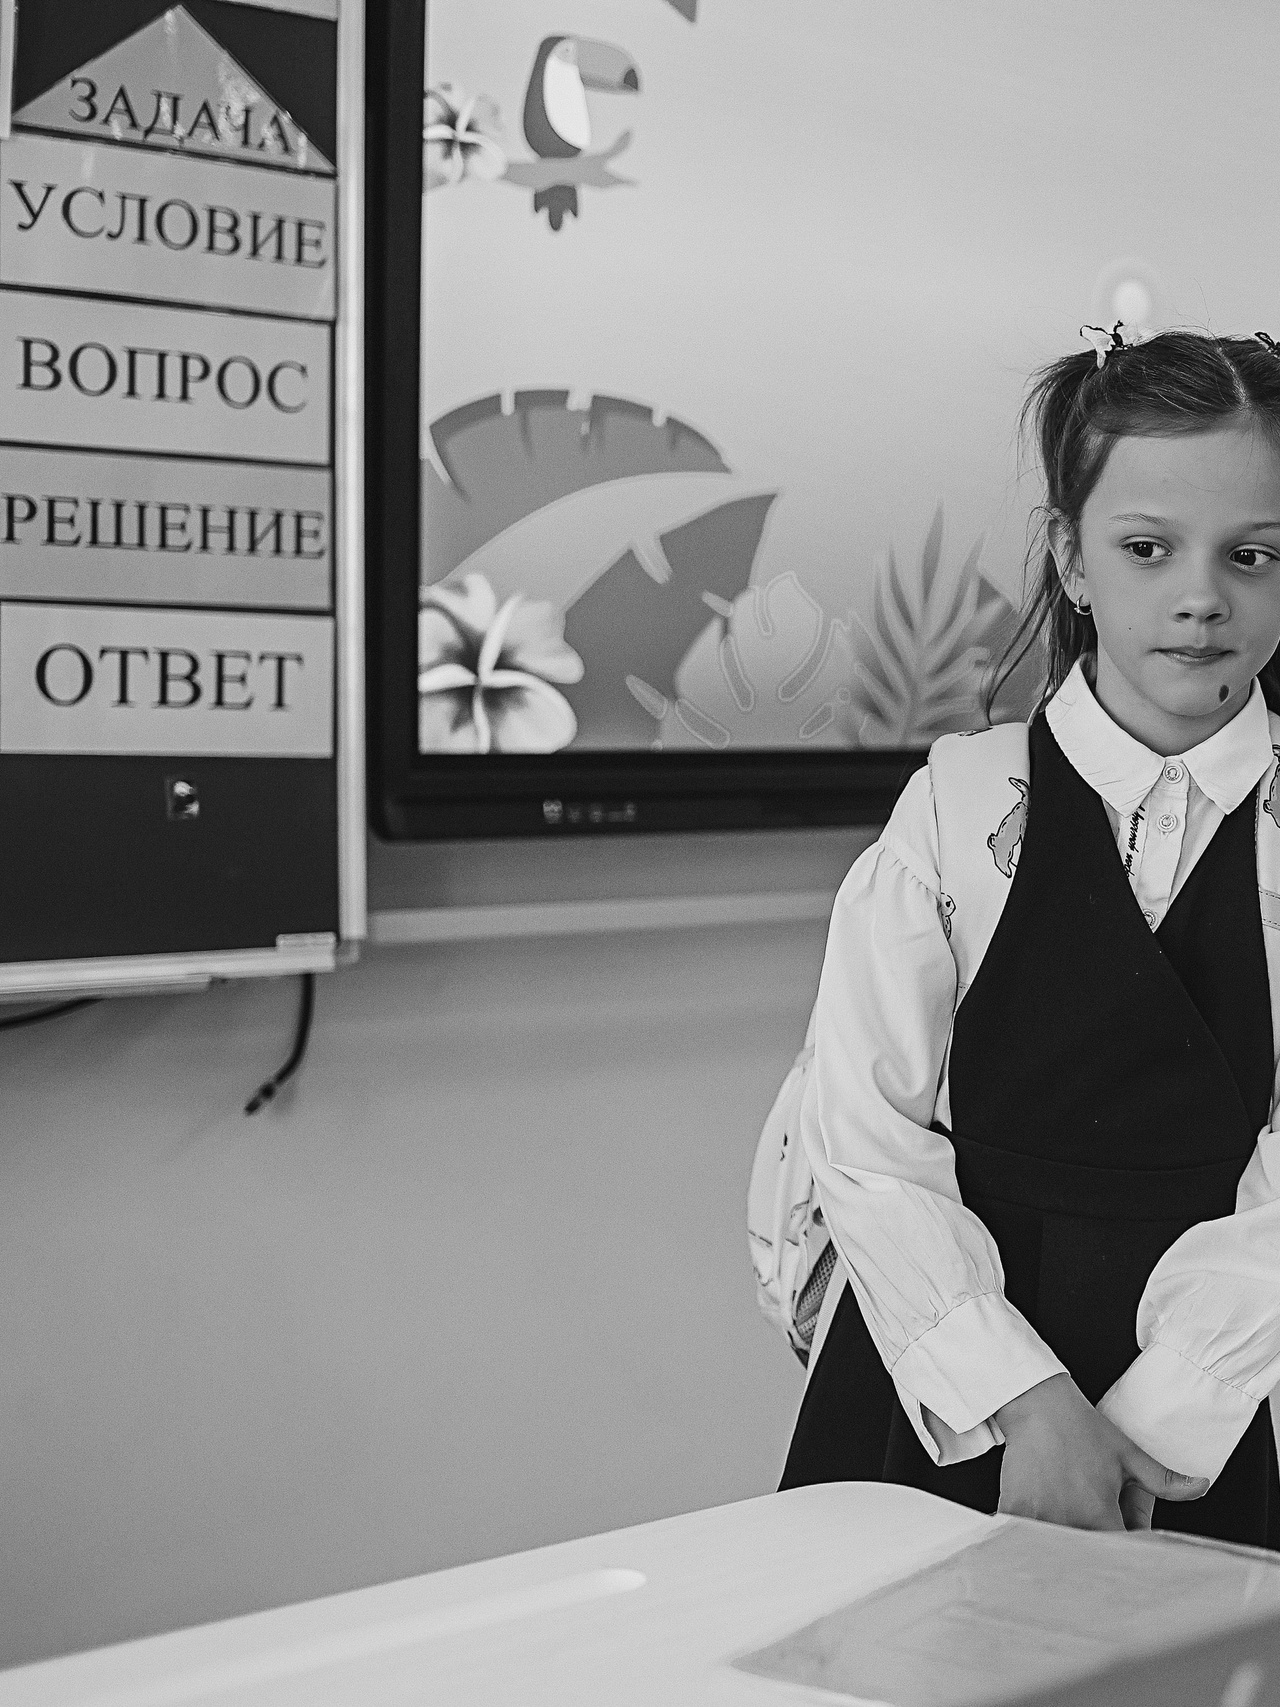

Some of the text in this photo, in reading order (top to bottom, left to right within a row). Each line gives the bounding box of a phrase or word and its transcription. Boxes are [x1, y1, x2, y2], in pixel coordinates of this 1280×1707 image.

[68, 76, 295, 156] ЗАДАЧА
[9, 179, 328, 270] УСЛОВИЕ
[16, 336, 310, 414] ВОПРОС
[1, 493, 328, 560] РЕШЕНИЕ
[35, 642, 305, 712] ОТВЕТ
